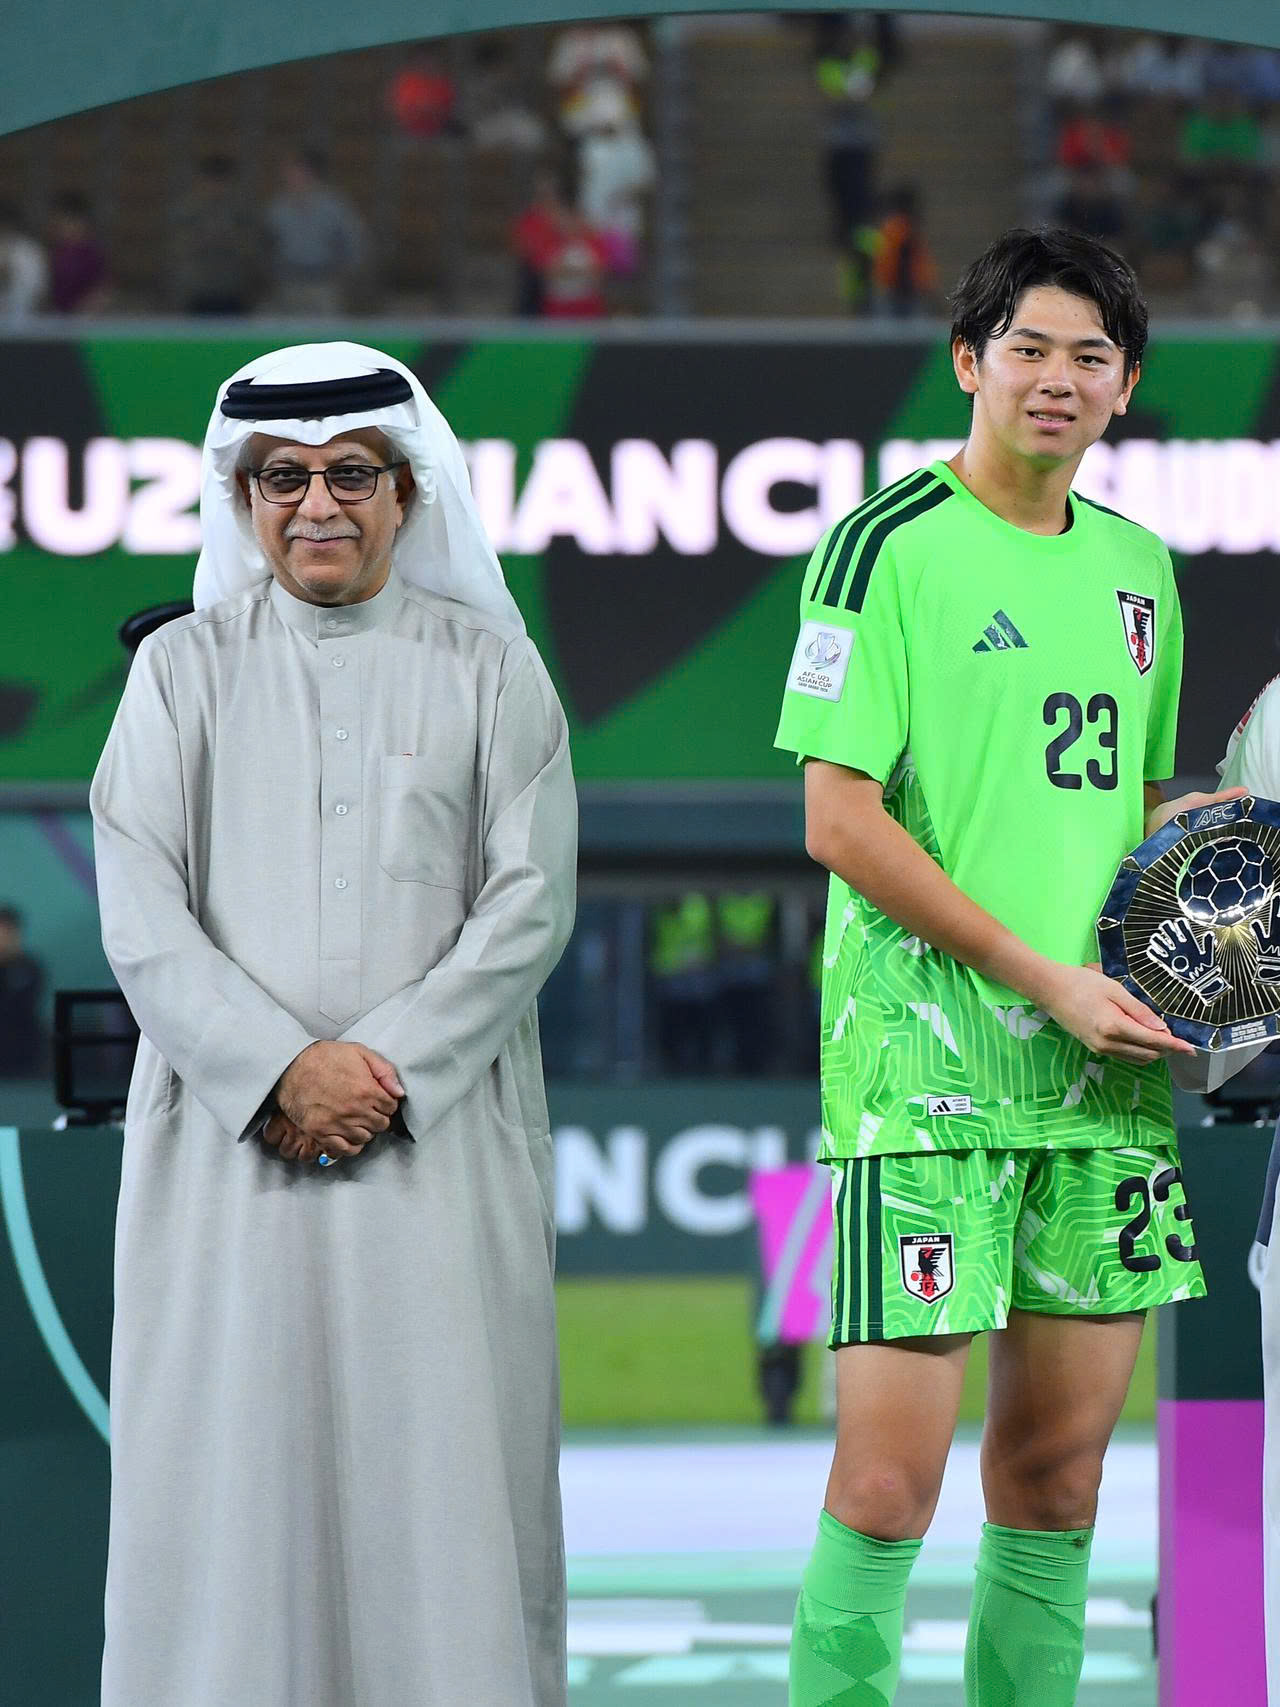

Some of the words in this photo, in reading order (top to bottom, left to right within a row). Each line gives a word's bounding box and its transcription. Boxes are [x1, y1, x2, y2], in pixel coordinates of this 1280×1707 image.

[23, 435, 204, 556] U2
[464, 437, 719, 556] IAN
[1042, 692, 1119, 790] 23
[1193, 802, 1236, 829] AFC
[911, 1236, 940, 1244] JAPAN
[1114, 1166, 1200, 1272] 23
[917, 1281, 940, 1292] JFA
